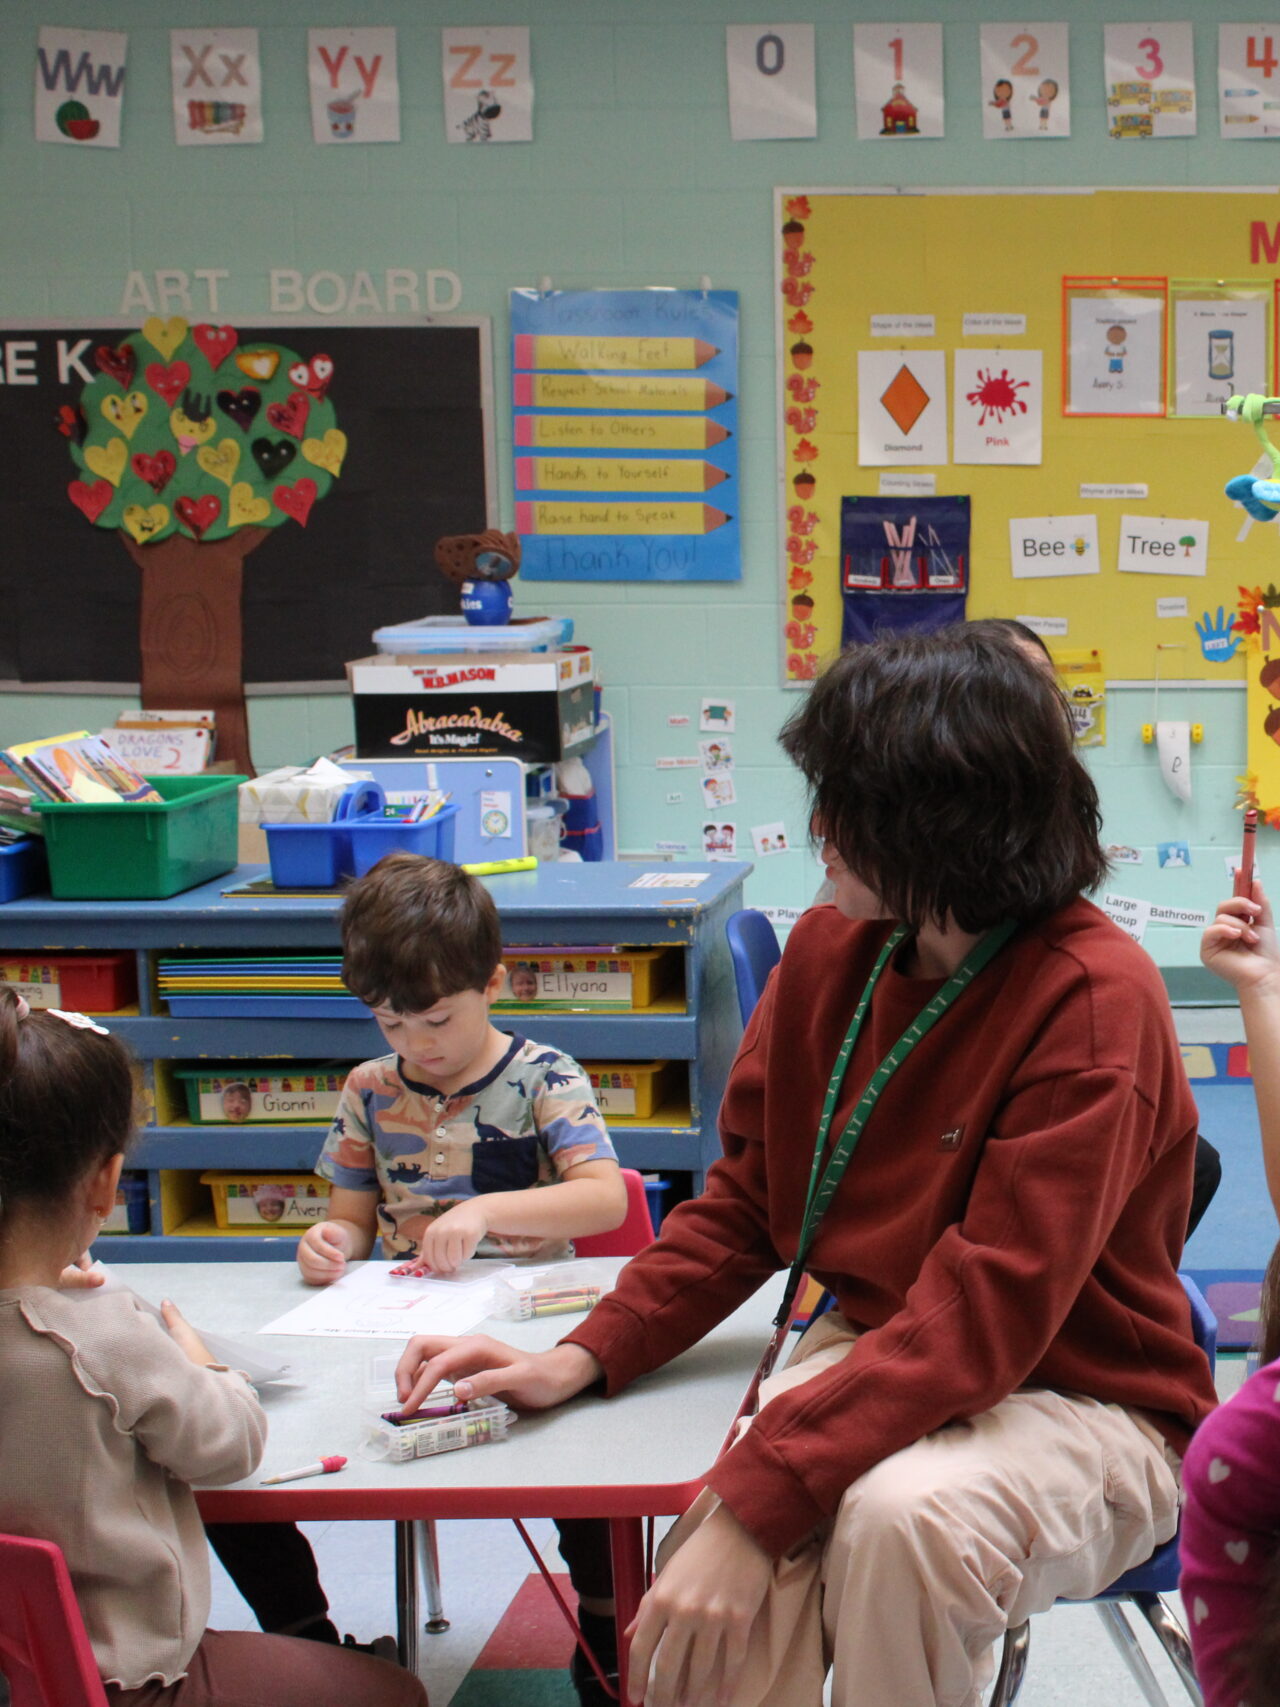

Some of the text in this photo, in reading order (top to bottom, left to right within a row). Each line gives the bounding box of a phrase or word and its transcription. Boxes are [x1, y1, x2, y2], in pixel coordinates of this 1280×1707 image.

[180, 44, 249, 88] Xx
[755, 34, 785, 76] 0
[887, 37, 905, 81] 1
[1009, 34, 1041, 76] 2
[1135, 37, 1165, 80] 3
[1246, 36, 1278, 78] 4
[38, 46, 127, 97] Ww
[317, 45, 383, 98] Yy
[448, 45, 517, 88] Zz
[119, 268, 464, 316] ART BOARD
[637, 337, 670, 361] Feet
[0, 339, 96, 385] E K
[539, 416, 657, 438] Listen to Others
[884, 443, 923, 452] Diamond
[985, 437, 1010, 447] Pink
[544, 464, 670, 481] Hands to Yourself
[580, 507, 609, 523] hand
[617, 509, 629, 521] to
[635, 508, 677, 525] Speak
[531, 535, 697, 573] Thank You!
[1022, 538, 1066, 557] Bee
[1127, 535, 1176, 556] Tree
[391, 706, 524, 745] Abracadabra
[669, 717, 689, 725] Math
[118, 733, 184, 747] DRAGONS
[121, 746, 162, 758] LOVE
[163, 747, 182, 769] 2
[669, 794, 681, 802] Art
[656, 842, 687, 851] Science
[777, 908, 802, 920] Play
[1105, 896, 1137, 911] Large
[1150, 907, 1206, 923] Bathroom
[542, 974, 608, 998] Ellyana
